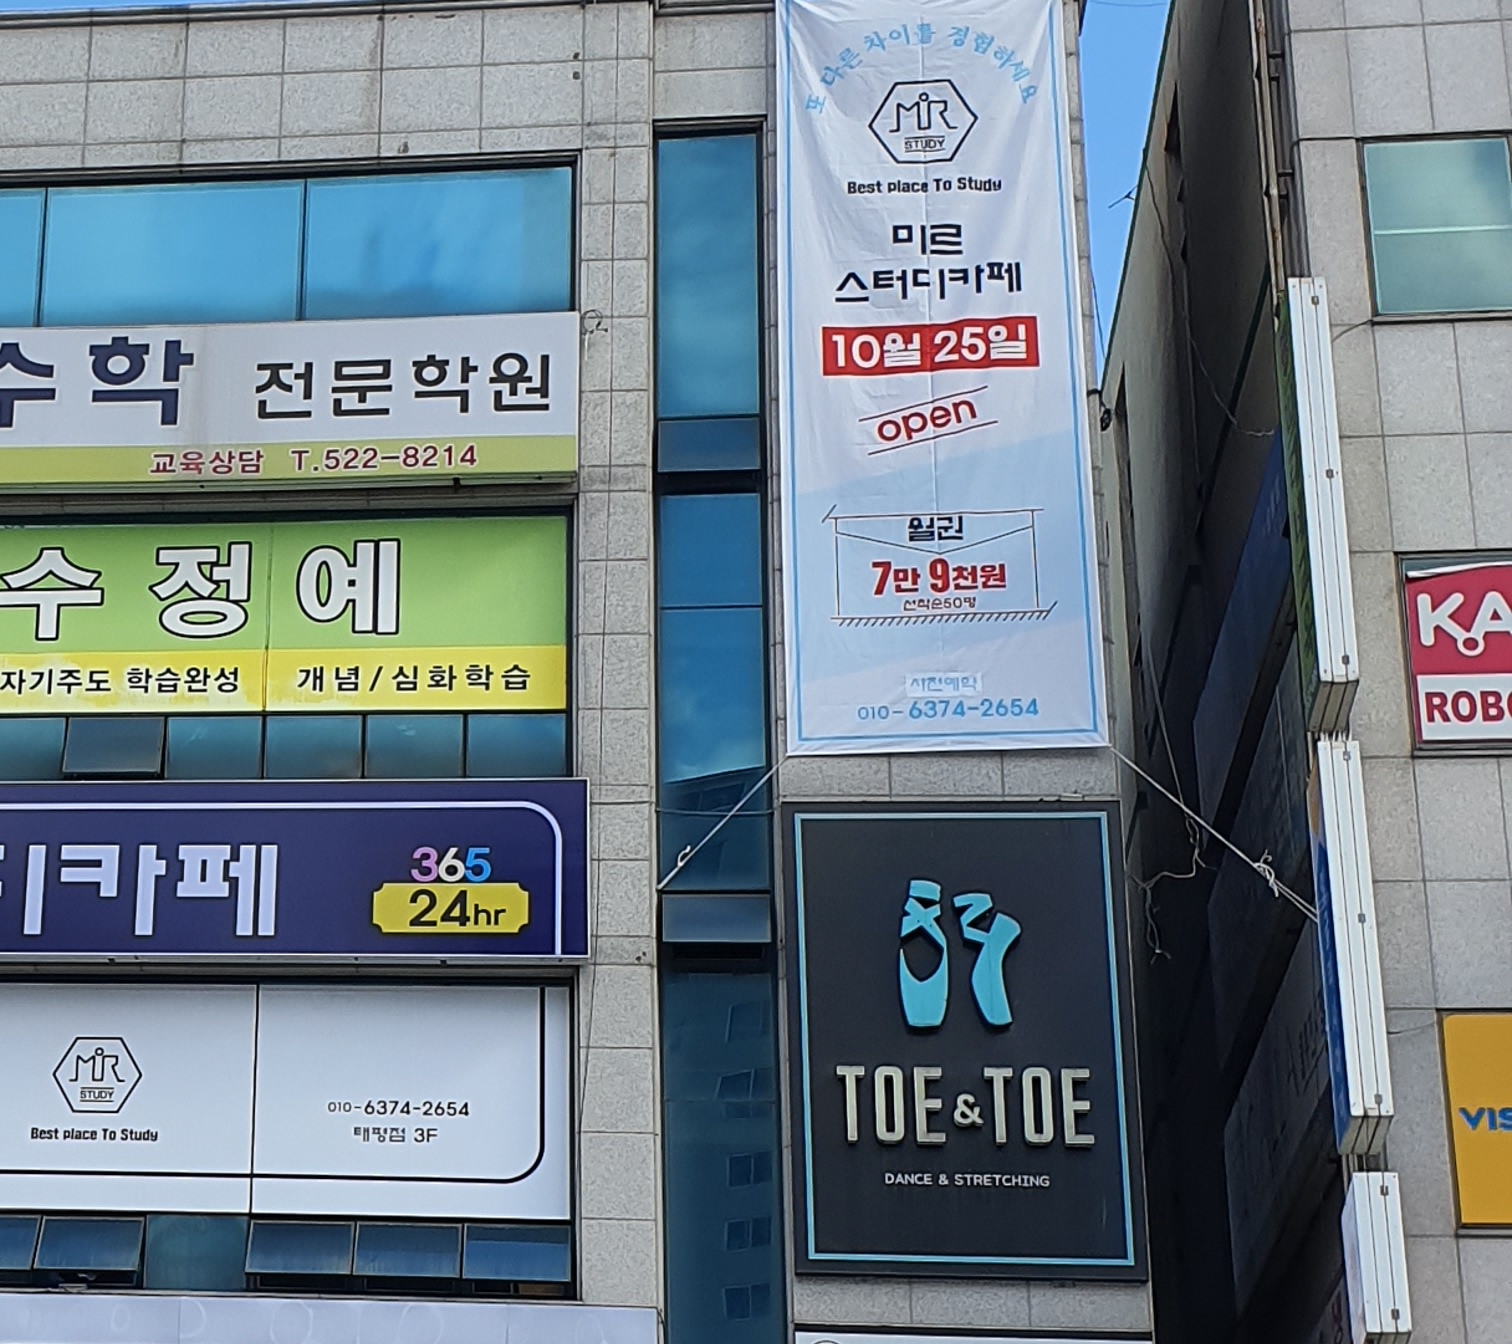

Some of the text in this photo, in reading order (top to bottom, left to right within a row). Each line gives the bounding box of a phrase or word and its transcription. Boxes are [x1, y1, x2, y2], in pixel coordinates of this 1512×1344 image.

[820, 47, 864, 87] 다른
[863, 22, 937, 52] 차이를
[947, 25, 1038, 105] 경험하세요
[904, 138, 946, 151] STUDY
[847, 177, 1002, 195] Best place To Study
[892, 223, 963, 256] 미르
[834, 261, 1022, 304] 스터디카페
[831, 323, 1028, 369] 10월 25일
[255, 351, 551, 421] 전문학원
[877, 397, 978, 443] open
[149, 448, 264, 476] 교육상담
[291, 443, 478, 473] T.522-8214
[871, 557, 1007, 597] 7만 9천원
[125, 665, 241, 695] 학습완성
[1424, 690, 1512, 724] ROB
[409, 845, 492, 884] 365
[407, 887, 507, 930] 24hr
[79, 1088, 114, 1101] STUDY
[327, 1099, 470, 1118] 010-6374-2654
[30, 1126, 159, 1144] Best place To Study
[353, 1124, 439, 1144] 태평점 3F
[884, 1172, 1050, 1188] DANCE & STRETCHING
